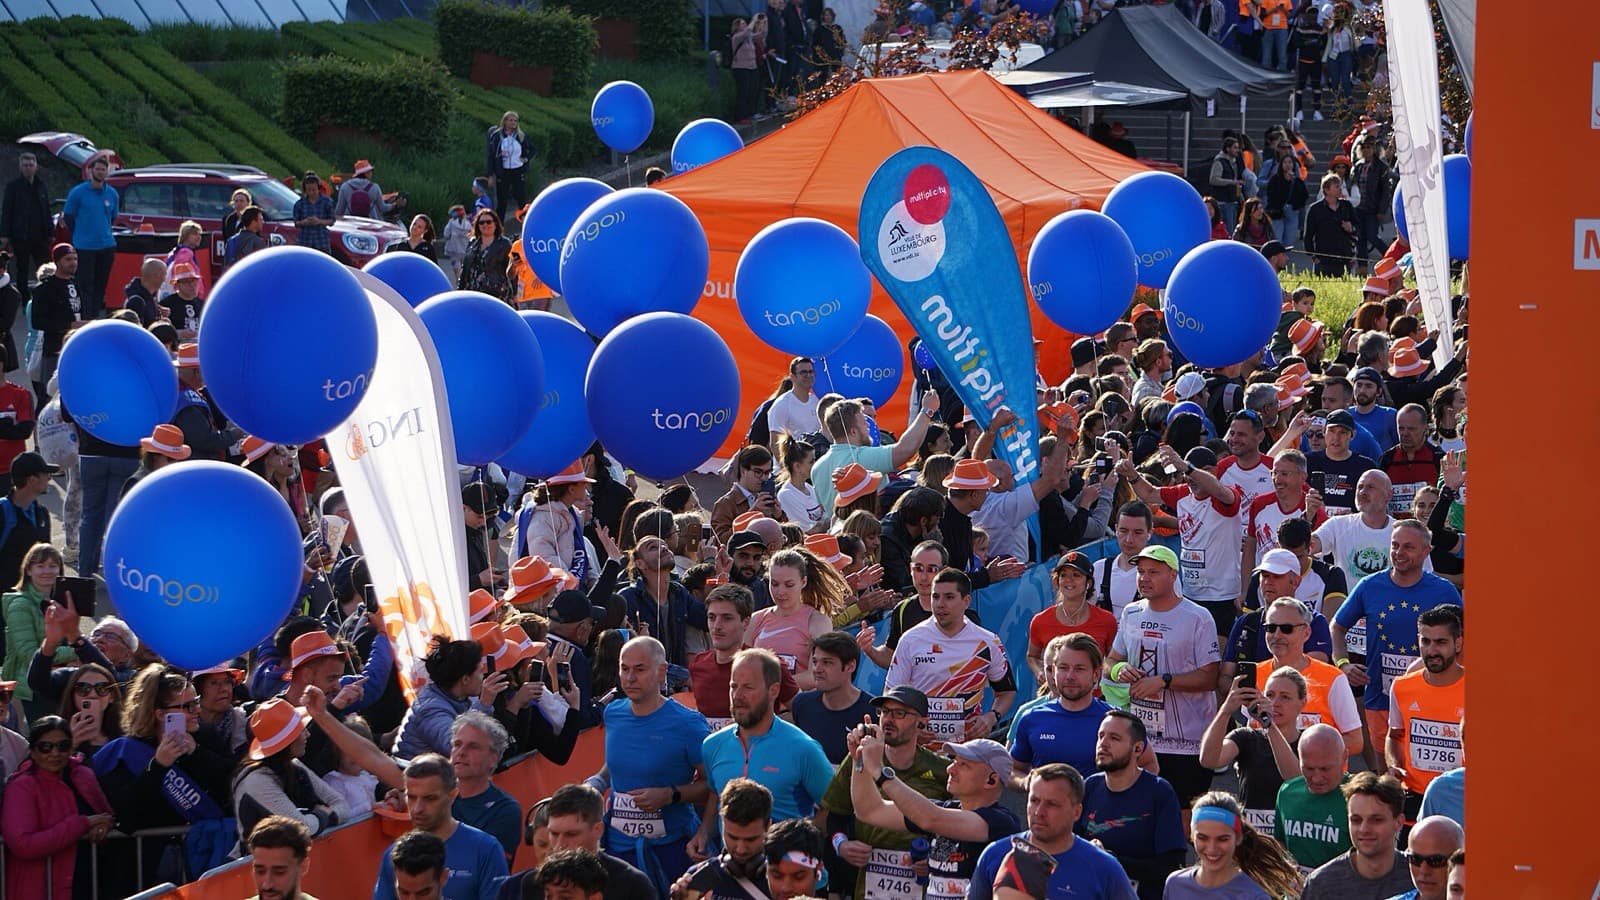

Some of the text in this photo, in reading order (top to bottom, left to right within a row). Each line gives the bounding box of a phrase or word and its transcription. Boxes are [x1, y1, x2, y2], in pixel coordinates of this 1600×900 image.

[890, 234, 937, 256] LUXEMBOURG
[764, 301, 834, 327] tango
[842, 362, 891, 382] tango
[651, 407, 725, 433] tango
[117, 557, 206, 607] tango
[1140, 621, 1159, 630] EDP
[915, 655, 936, 666] pwc
[1384, 656, 1407, 668] ING
[1414, 723, 1439, 736] ING
[1040, 733, 1056, 741] JAKO
[1412, 736, 1458, 748] LUXEMBOURG
[1417, 748, 1456, 763] 13786
[614, 810, 658, 820] LUXEMBOURG
[622, 822, 654, 834] 4769
[1284, 819, 1340, 844] MARTIN
[878, 877, 912, 894] 4746
